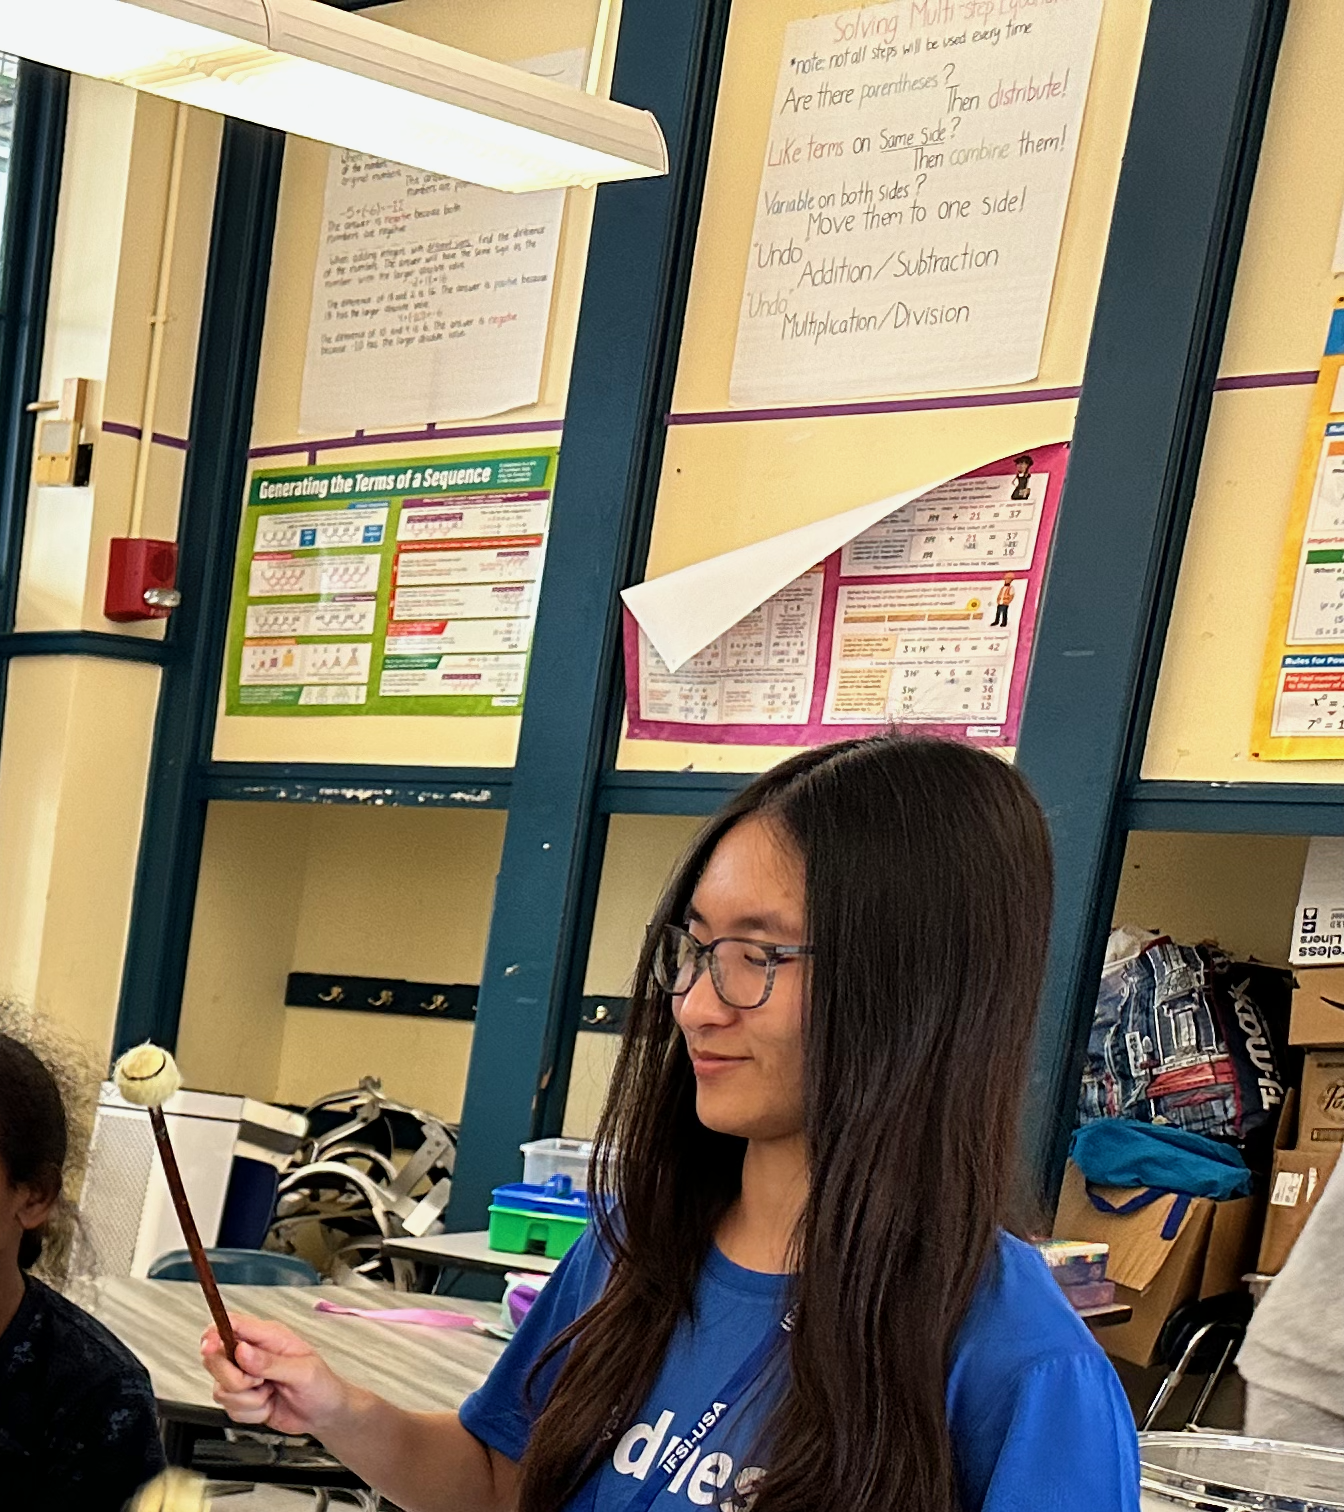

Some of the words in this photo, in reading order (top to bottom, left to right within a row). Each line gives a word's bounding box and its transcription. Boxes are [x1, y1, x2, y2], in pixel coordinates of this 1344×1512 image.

[833, 15, 898, 44] Solving
[851, 47, 866, 65] all
[871, 44, 897, 64] steps
[926, 37, 939, 51] be
[1005, 19, 1033, 36] time
[779, 87, 811, 115] Are
[817, 81, 854, 108] there
[946, 84, 980, 114] Then
[807, 134, 844, 162] terms
[852, 137, 871, 154] on
[912, 147, 943, 171] Then
[949, 140, 1010, 166] combine
[765, 189, 814, 216] Variable
[818, 193, 835, 209] on
[841, 181, 873, 207] both
[806, 211, 855, 239] Move
[863, 206, 903, 231] them
[911, 199, 927, 224] to
[938, 199, 971, 220] one
[259, 474, 327, 499] Generating
[330, 475, 352, 493] the
[355, 472, 394, 492] Terms
[396, 469, 412, 489] of
[412, 473, 422, 488] a
[424, 466, 491, 489] Sequence
[1285, 657, 1309, 665] Rules
[1312, 656, 1325, 664] for
[1299, 945, 1344, 959] eless
[662, 1401, 728, 1475] IFSI-USA
